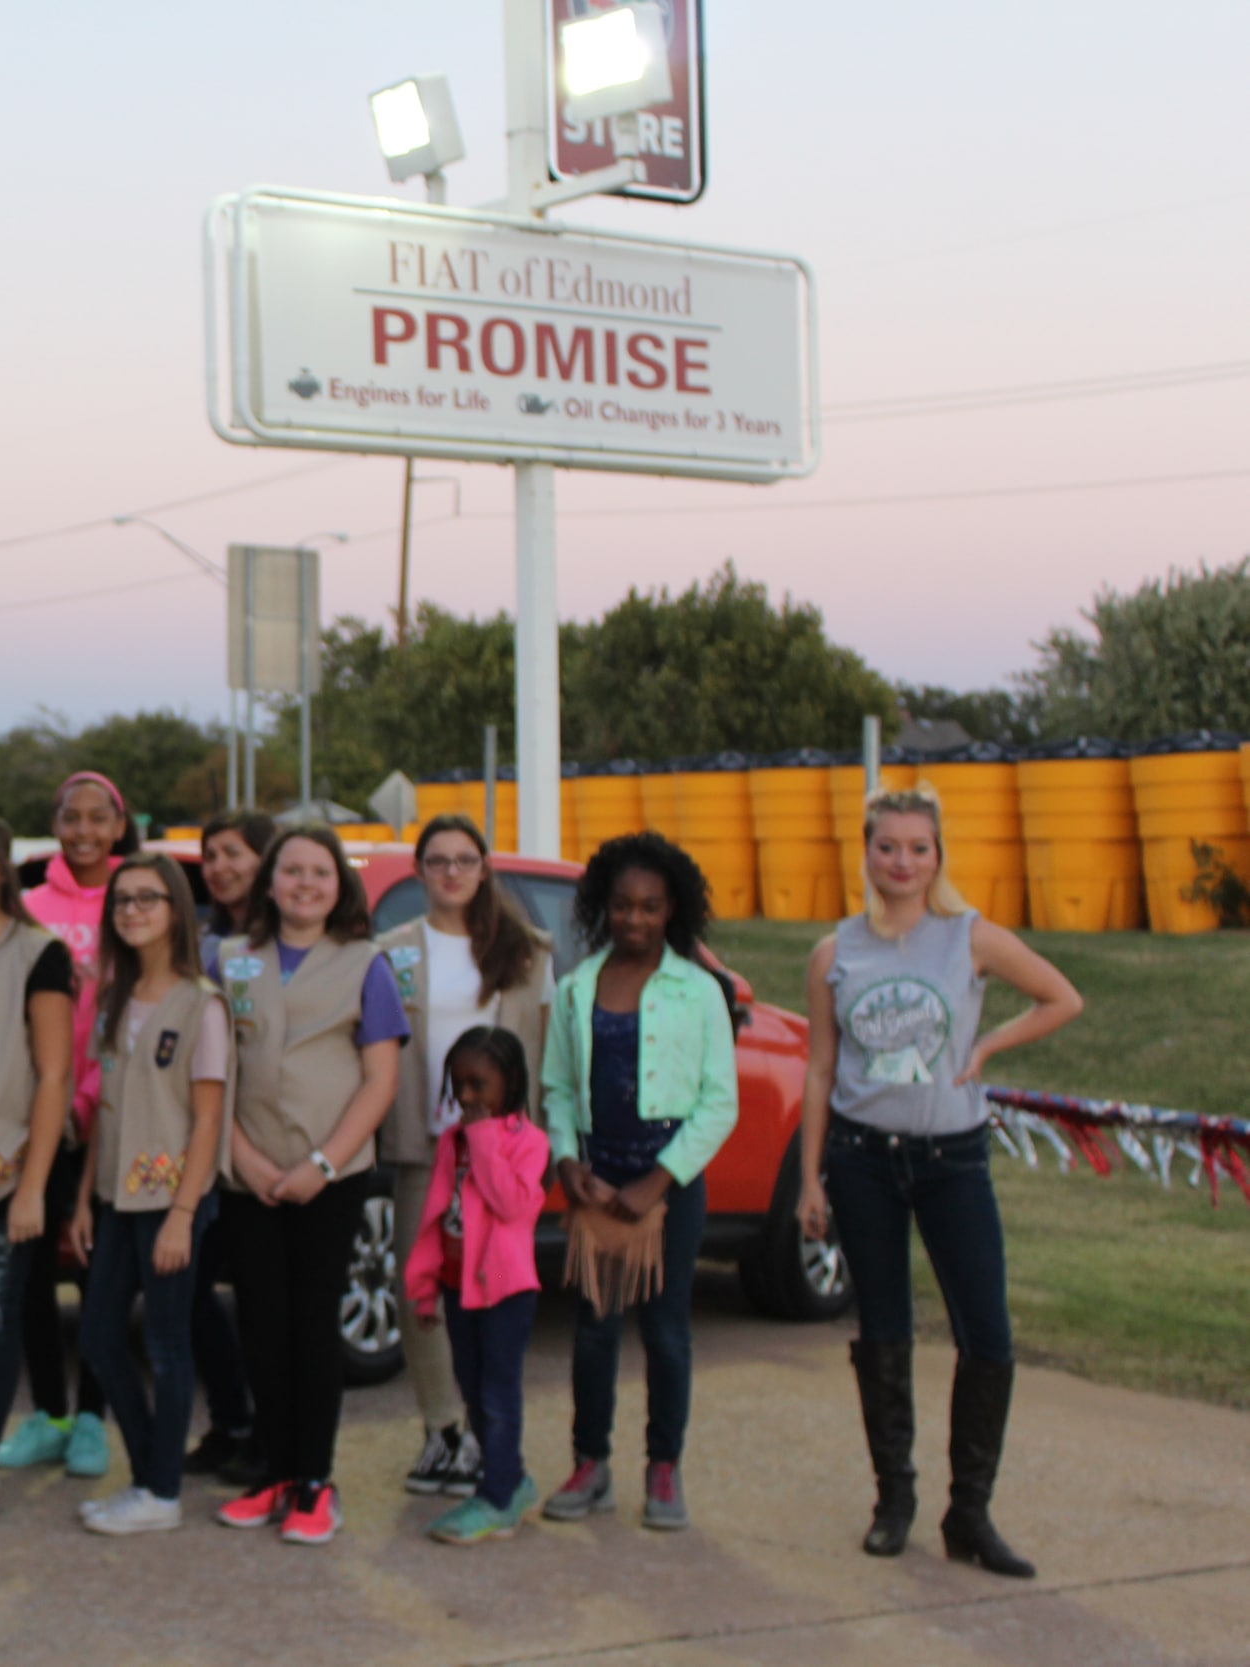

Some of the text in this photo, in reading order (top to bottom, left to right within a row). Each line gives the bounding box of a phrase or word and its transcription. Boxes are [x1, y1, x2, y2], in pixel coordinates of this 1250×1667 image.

[388, 240, 693, 316] FIAT of Edmond
[371, 305, 712, 395] PROMISE
[328, 377, 491, 411] Engines for Life
[564, 397, 784, 437] Oil Changes for 3 Years
